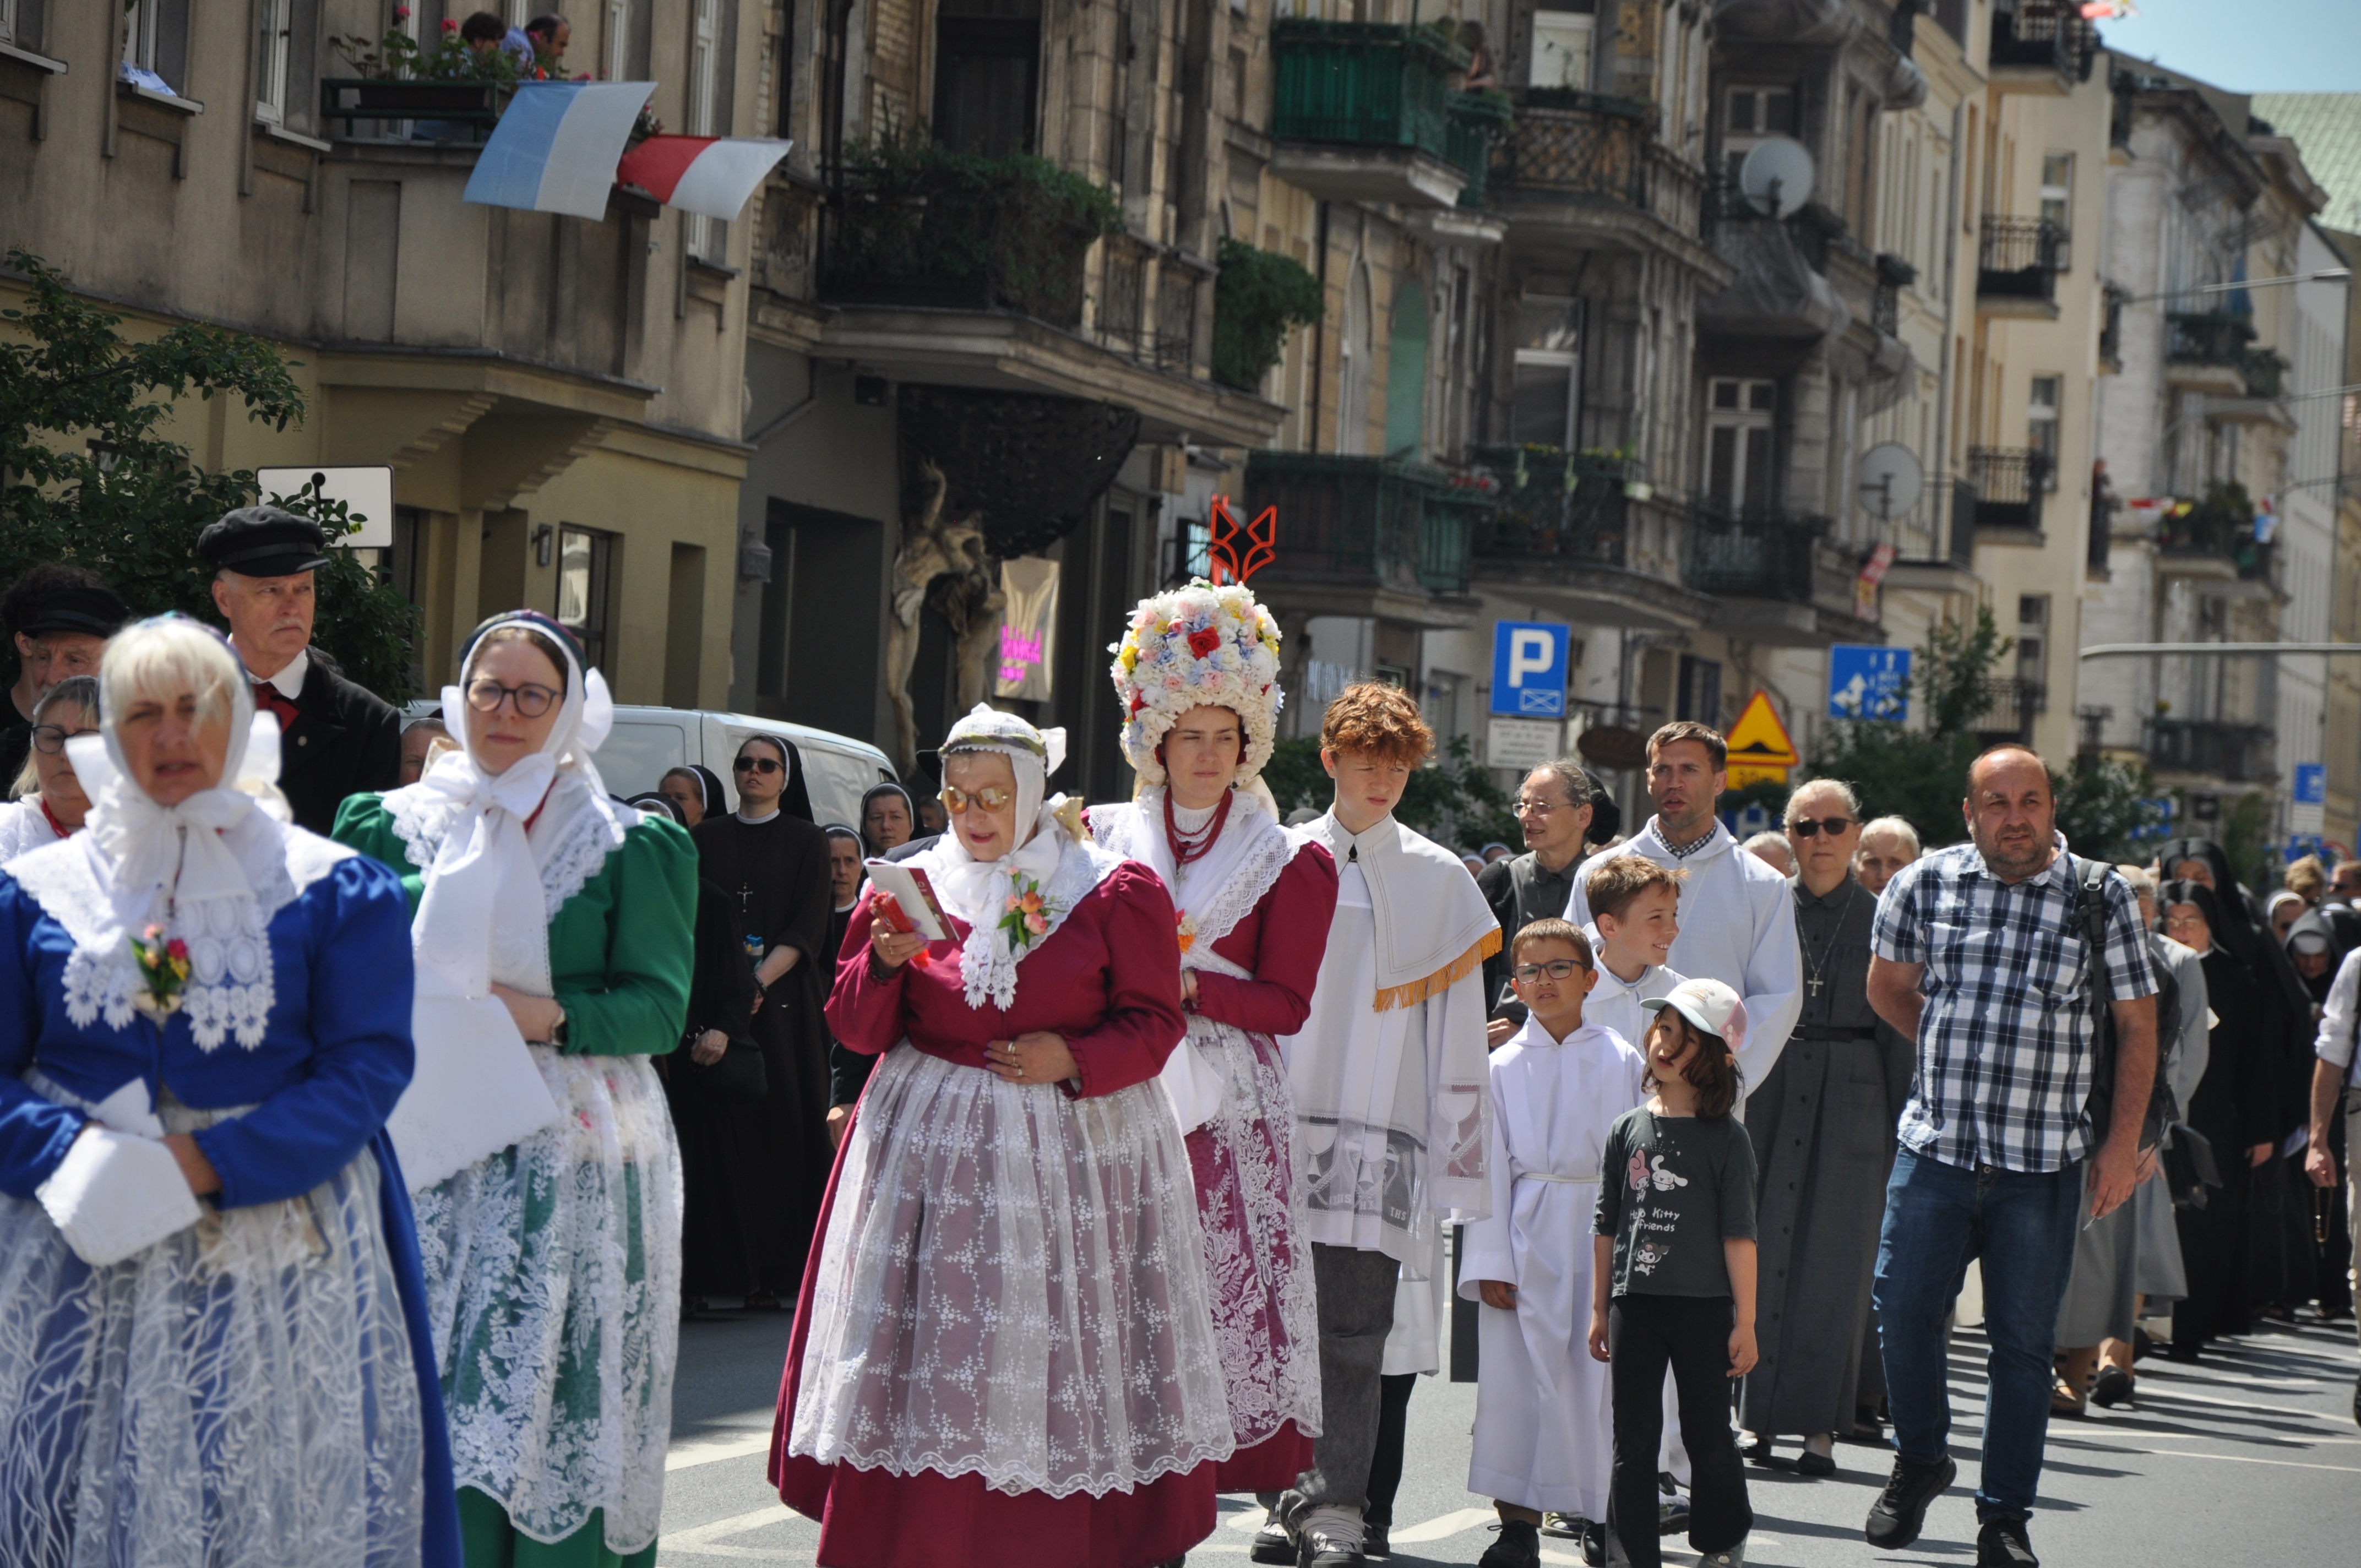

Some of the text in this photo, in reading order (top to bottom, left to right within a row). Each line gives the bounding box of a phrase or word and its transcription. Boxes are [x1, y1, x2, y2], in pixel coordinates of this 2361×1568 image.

[1508, 628, 1555, 688] P
[1390, 1206, 1407, 1222] IHS
[1652, 1207, 1679, 1221] Kitty
[1639, 1218, 1675, 1232] friends
